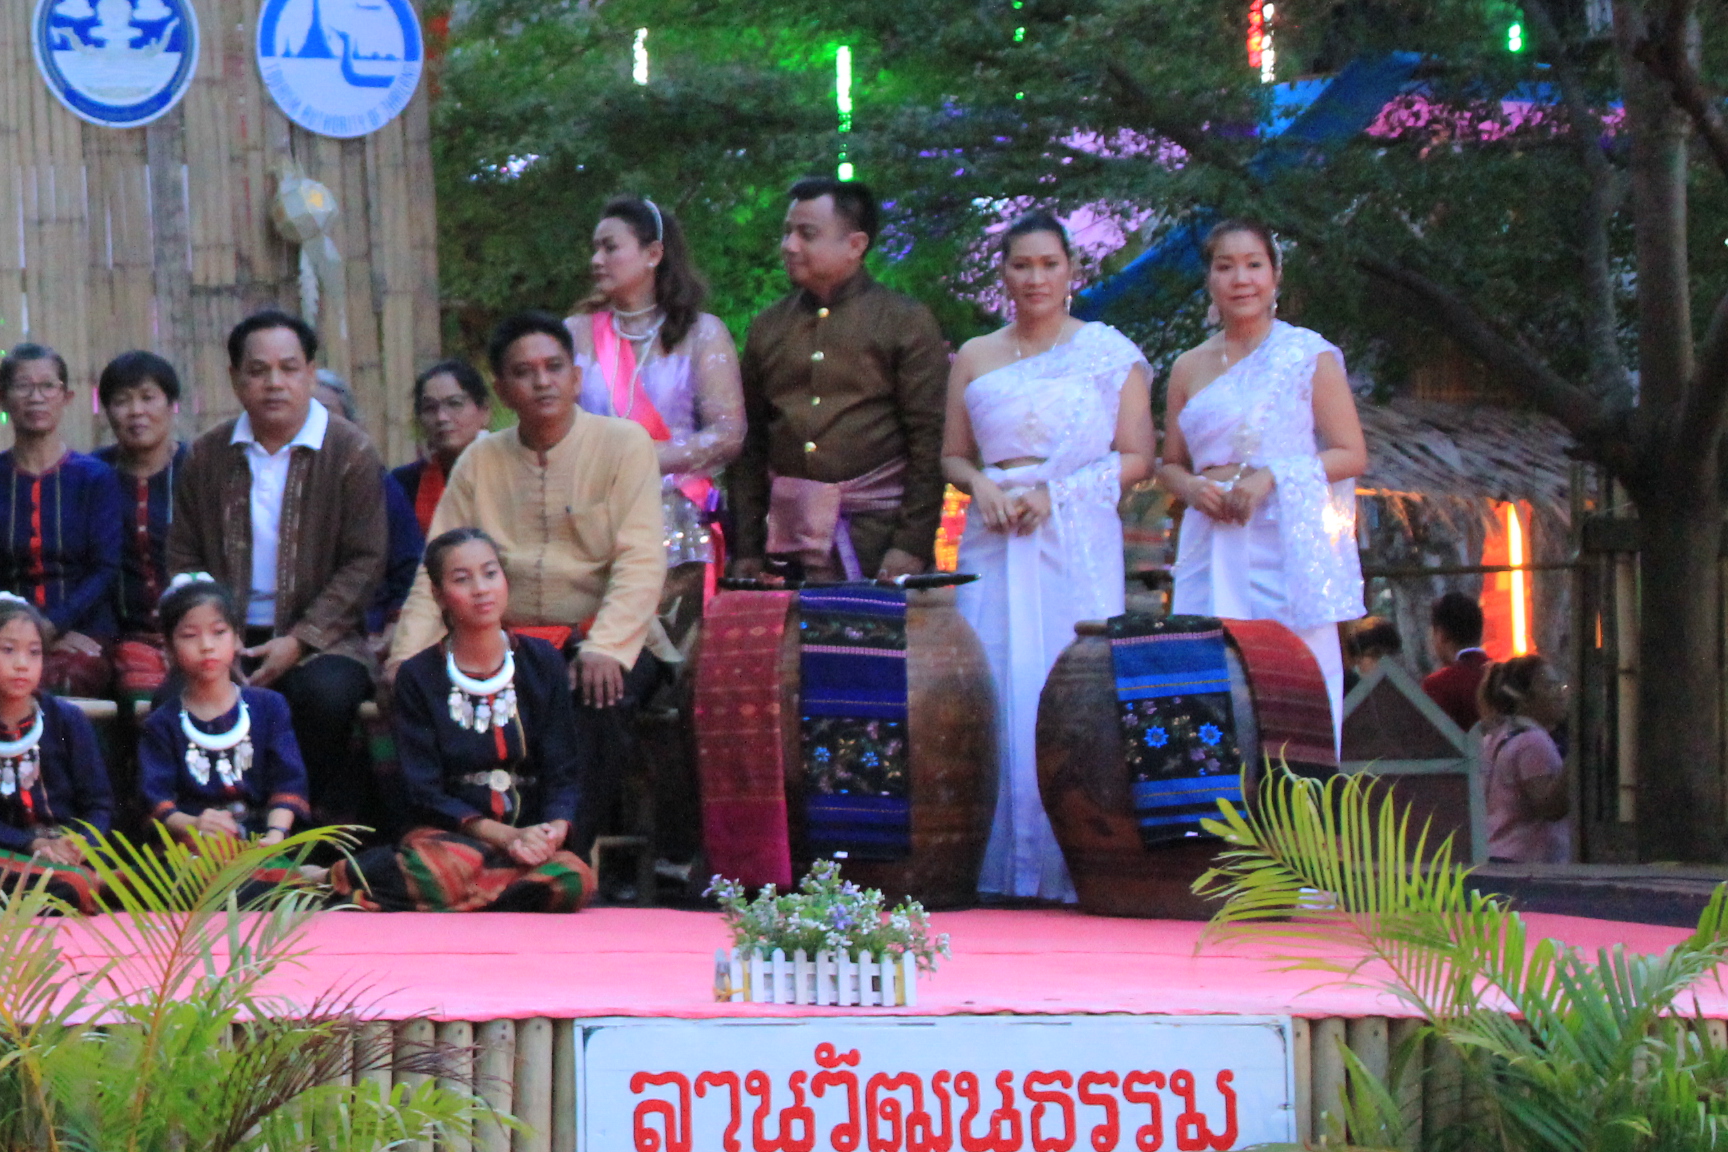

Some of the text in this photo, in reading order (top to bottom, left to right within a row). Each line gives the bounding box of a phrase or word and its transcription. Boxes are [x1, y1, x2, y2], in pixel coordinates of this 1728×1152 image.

[629, 1041, 1239, 1152] ลานวัฒนธรรม
